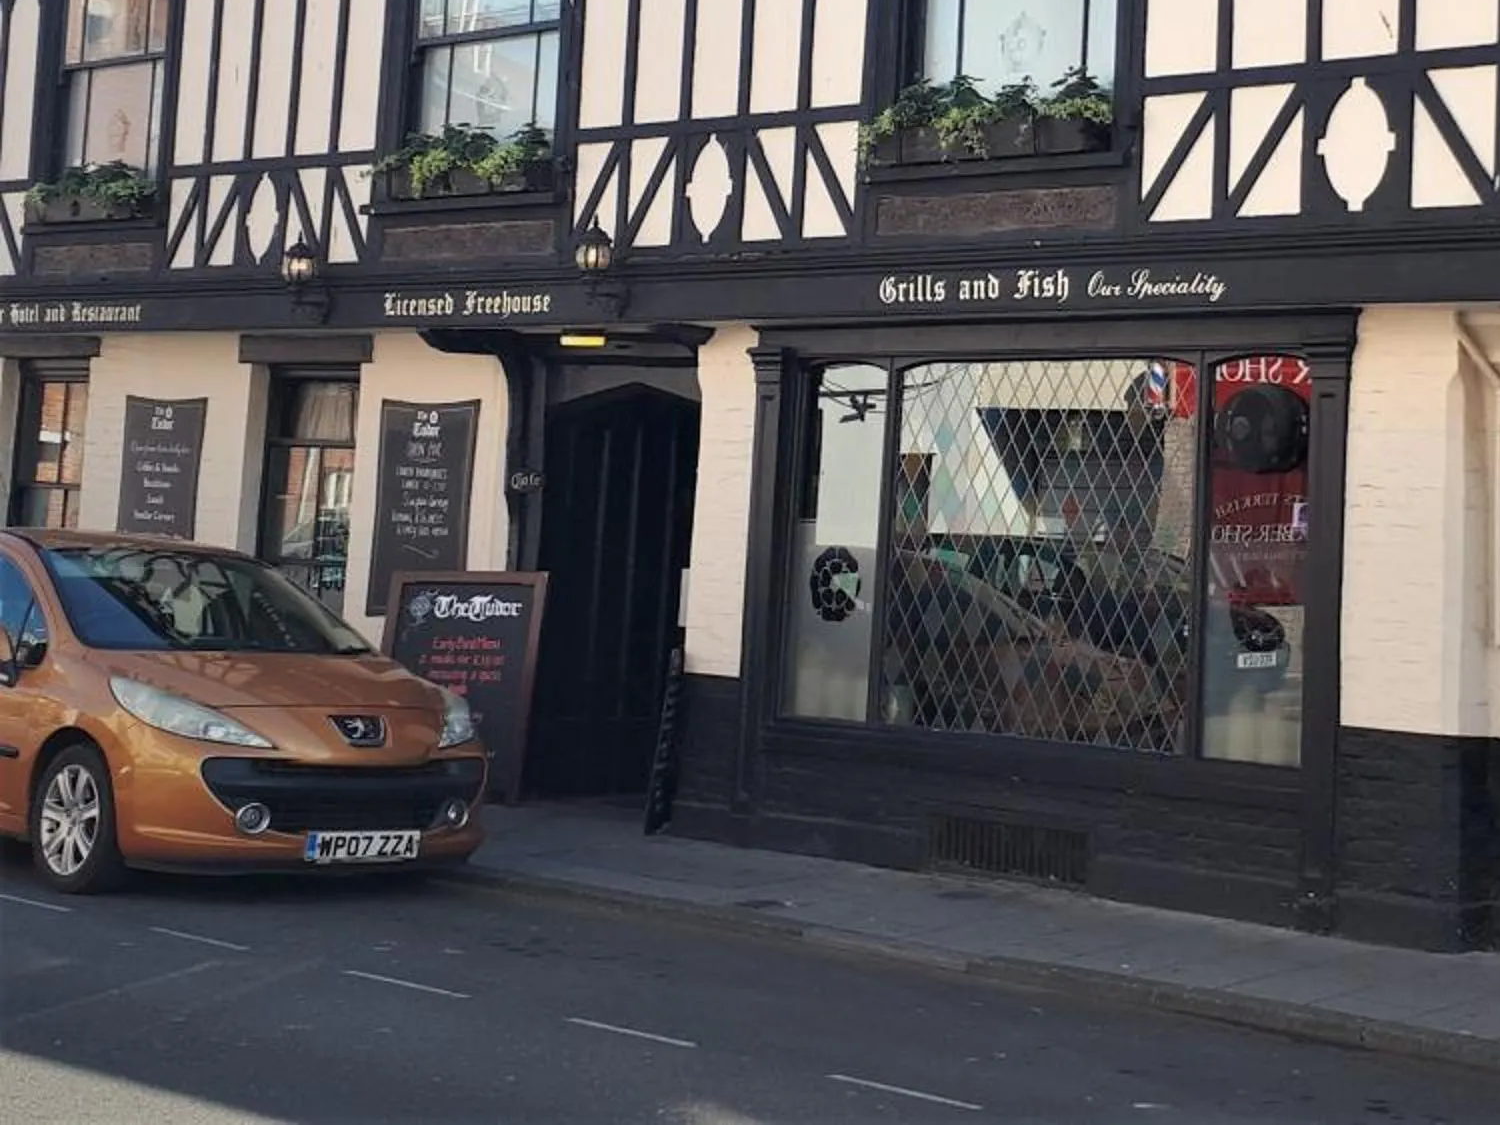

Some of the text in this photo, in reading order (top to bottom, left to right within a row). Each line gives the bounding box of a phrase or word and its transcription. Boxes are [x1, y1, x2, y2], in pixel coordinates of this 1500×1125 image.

[879, 268, 1225, 303] Grills and Fish Our Speciality
[10, 303, 39, 326] Hotel
[44, 303, 65, 322] and
[71, 301, 143, 322] Restaurant
[384, 290, 551, 319] Licensed Freehouse
[468, 594, 523, 621] Tudor
[319, 835, 415, 856] WP07 ZZA
